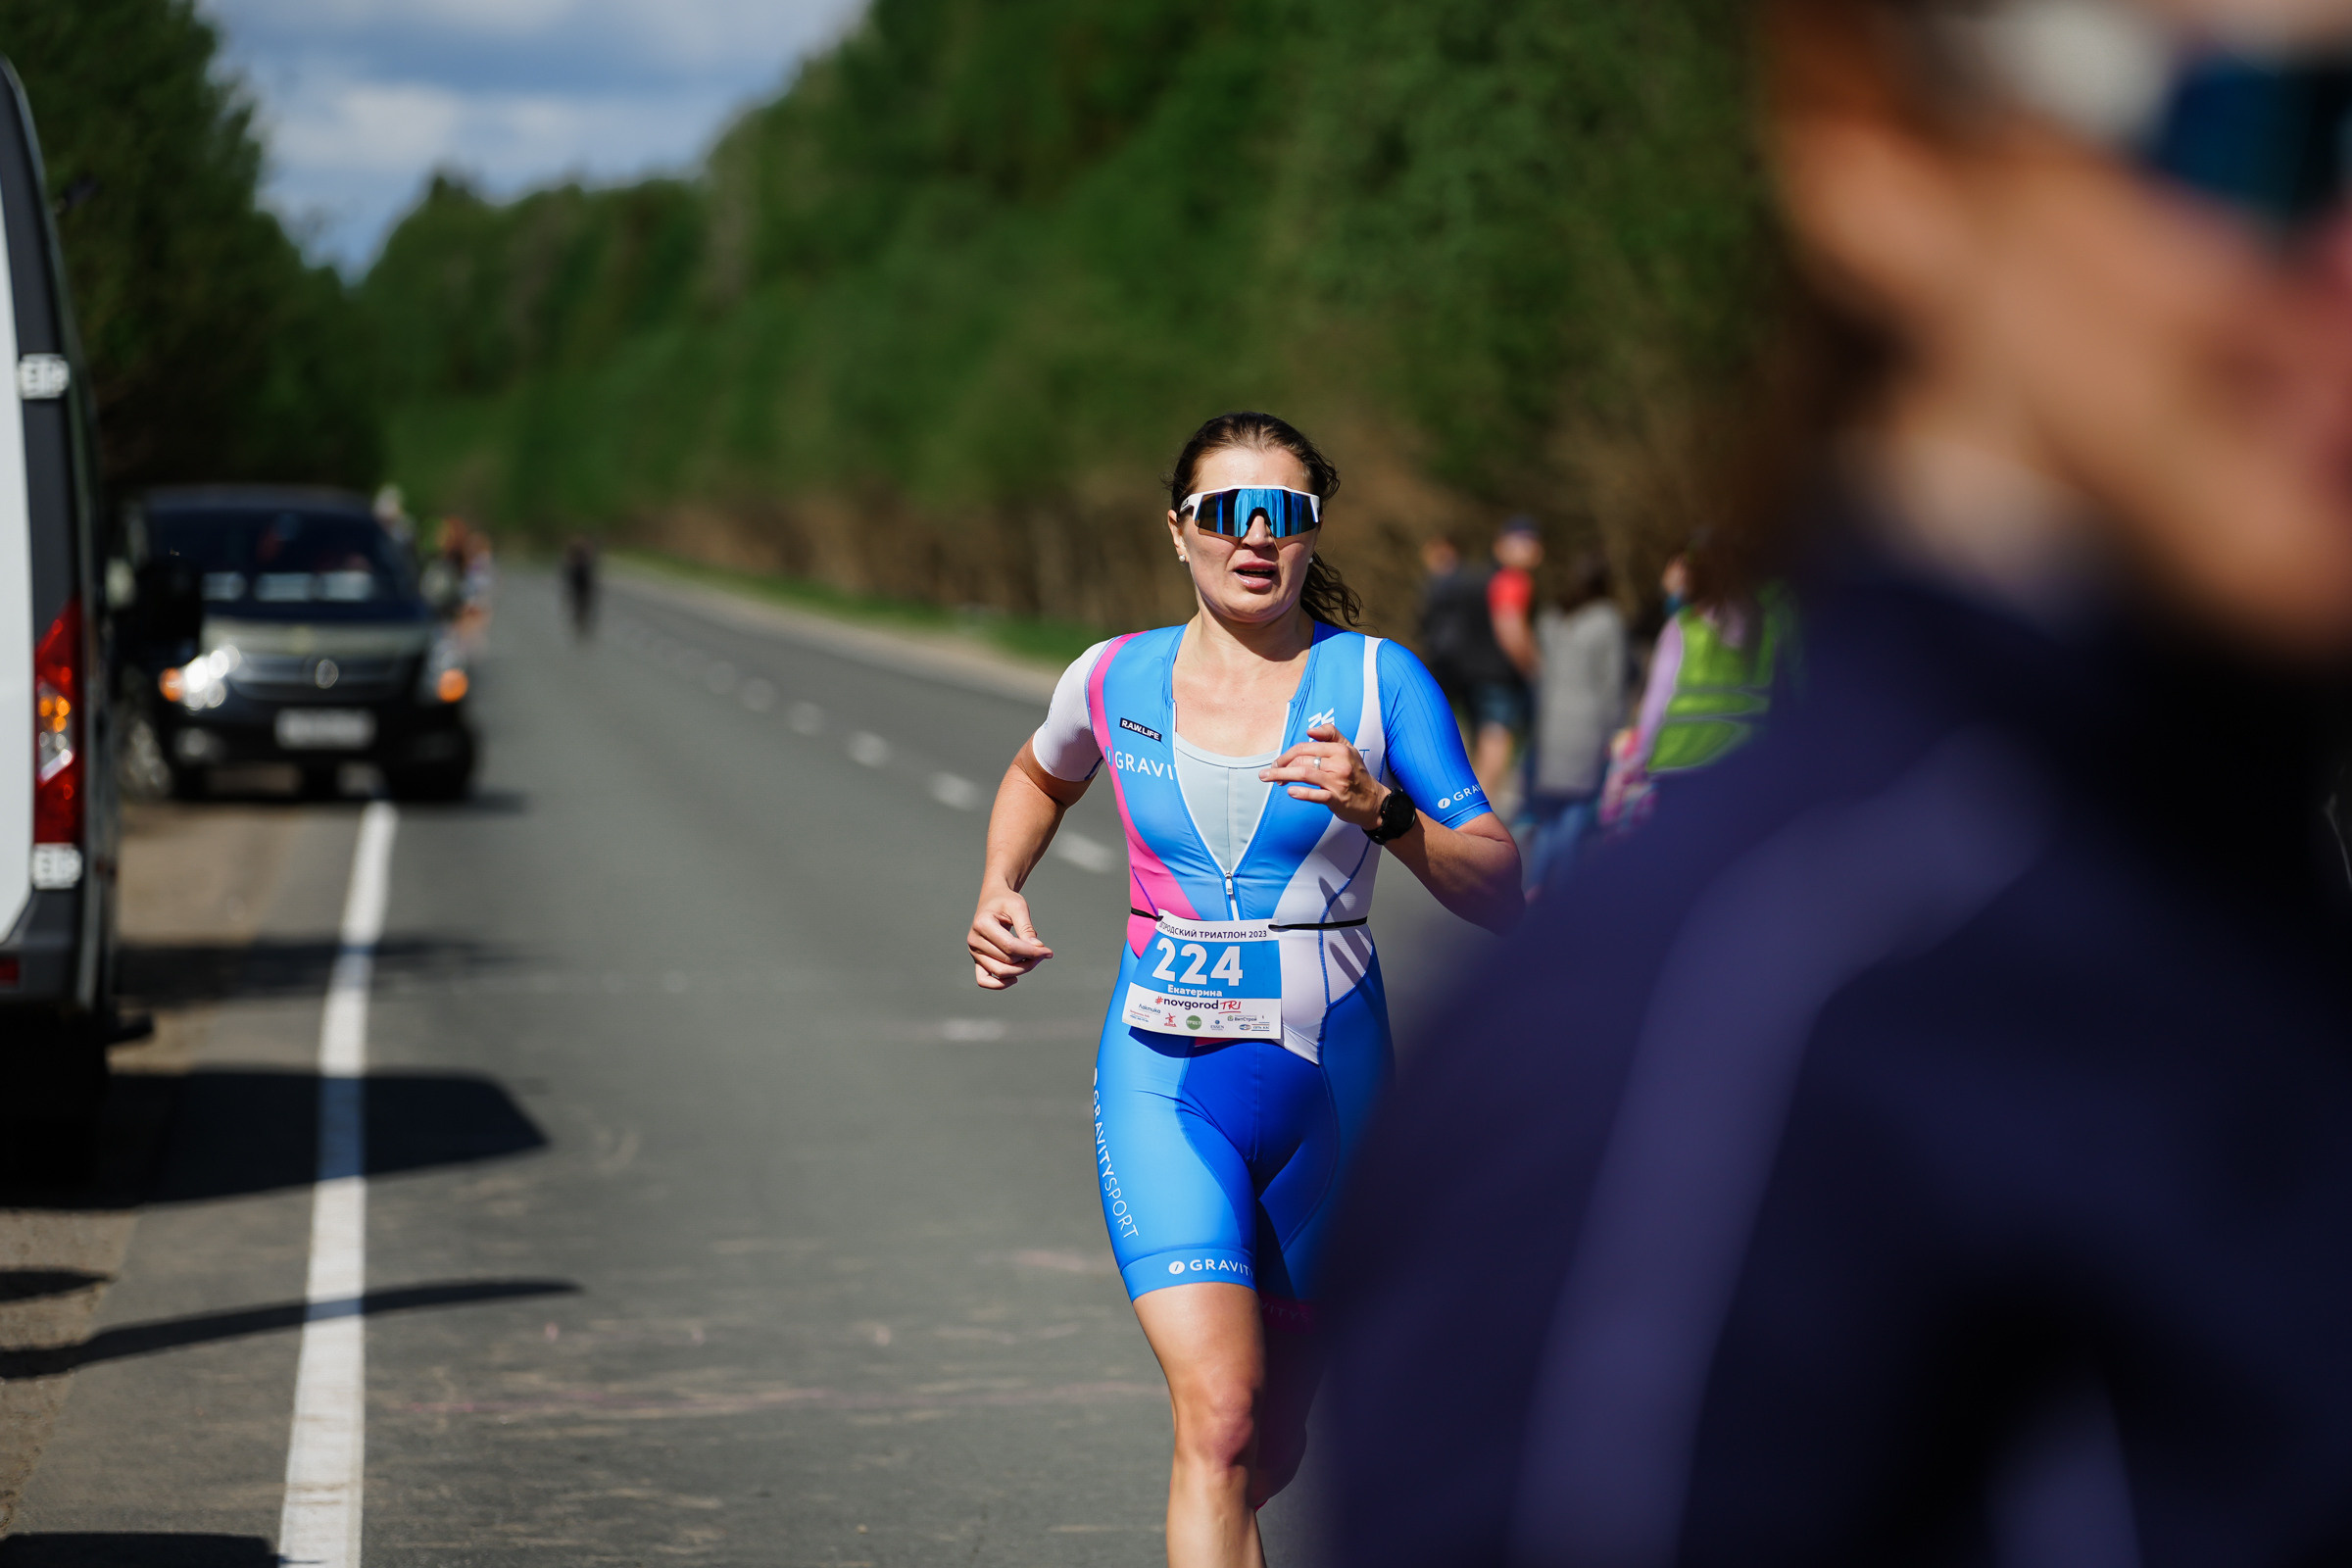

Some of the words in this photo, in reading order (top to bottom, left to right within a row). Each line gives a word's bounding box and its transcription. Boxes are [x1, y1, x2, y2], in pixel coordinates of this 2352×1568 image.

[1114, 750, 1177, 781] GRAVI
[1199, 930, 1247, 939] ТРИАТЛОН
[1249, 930, 1267, 939] 2023
[1152, 937, 1244, 987] 224
[1167, 984, 1223, 998] Екатерина
